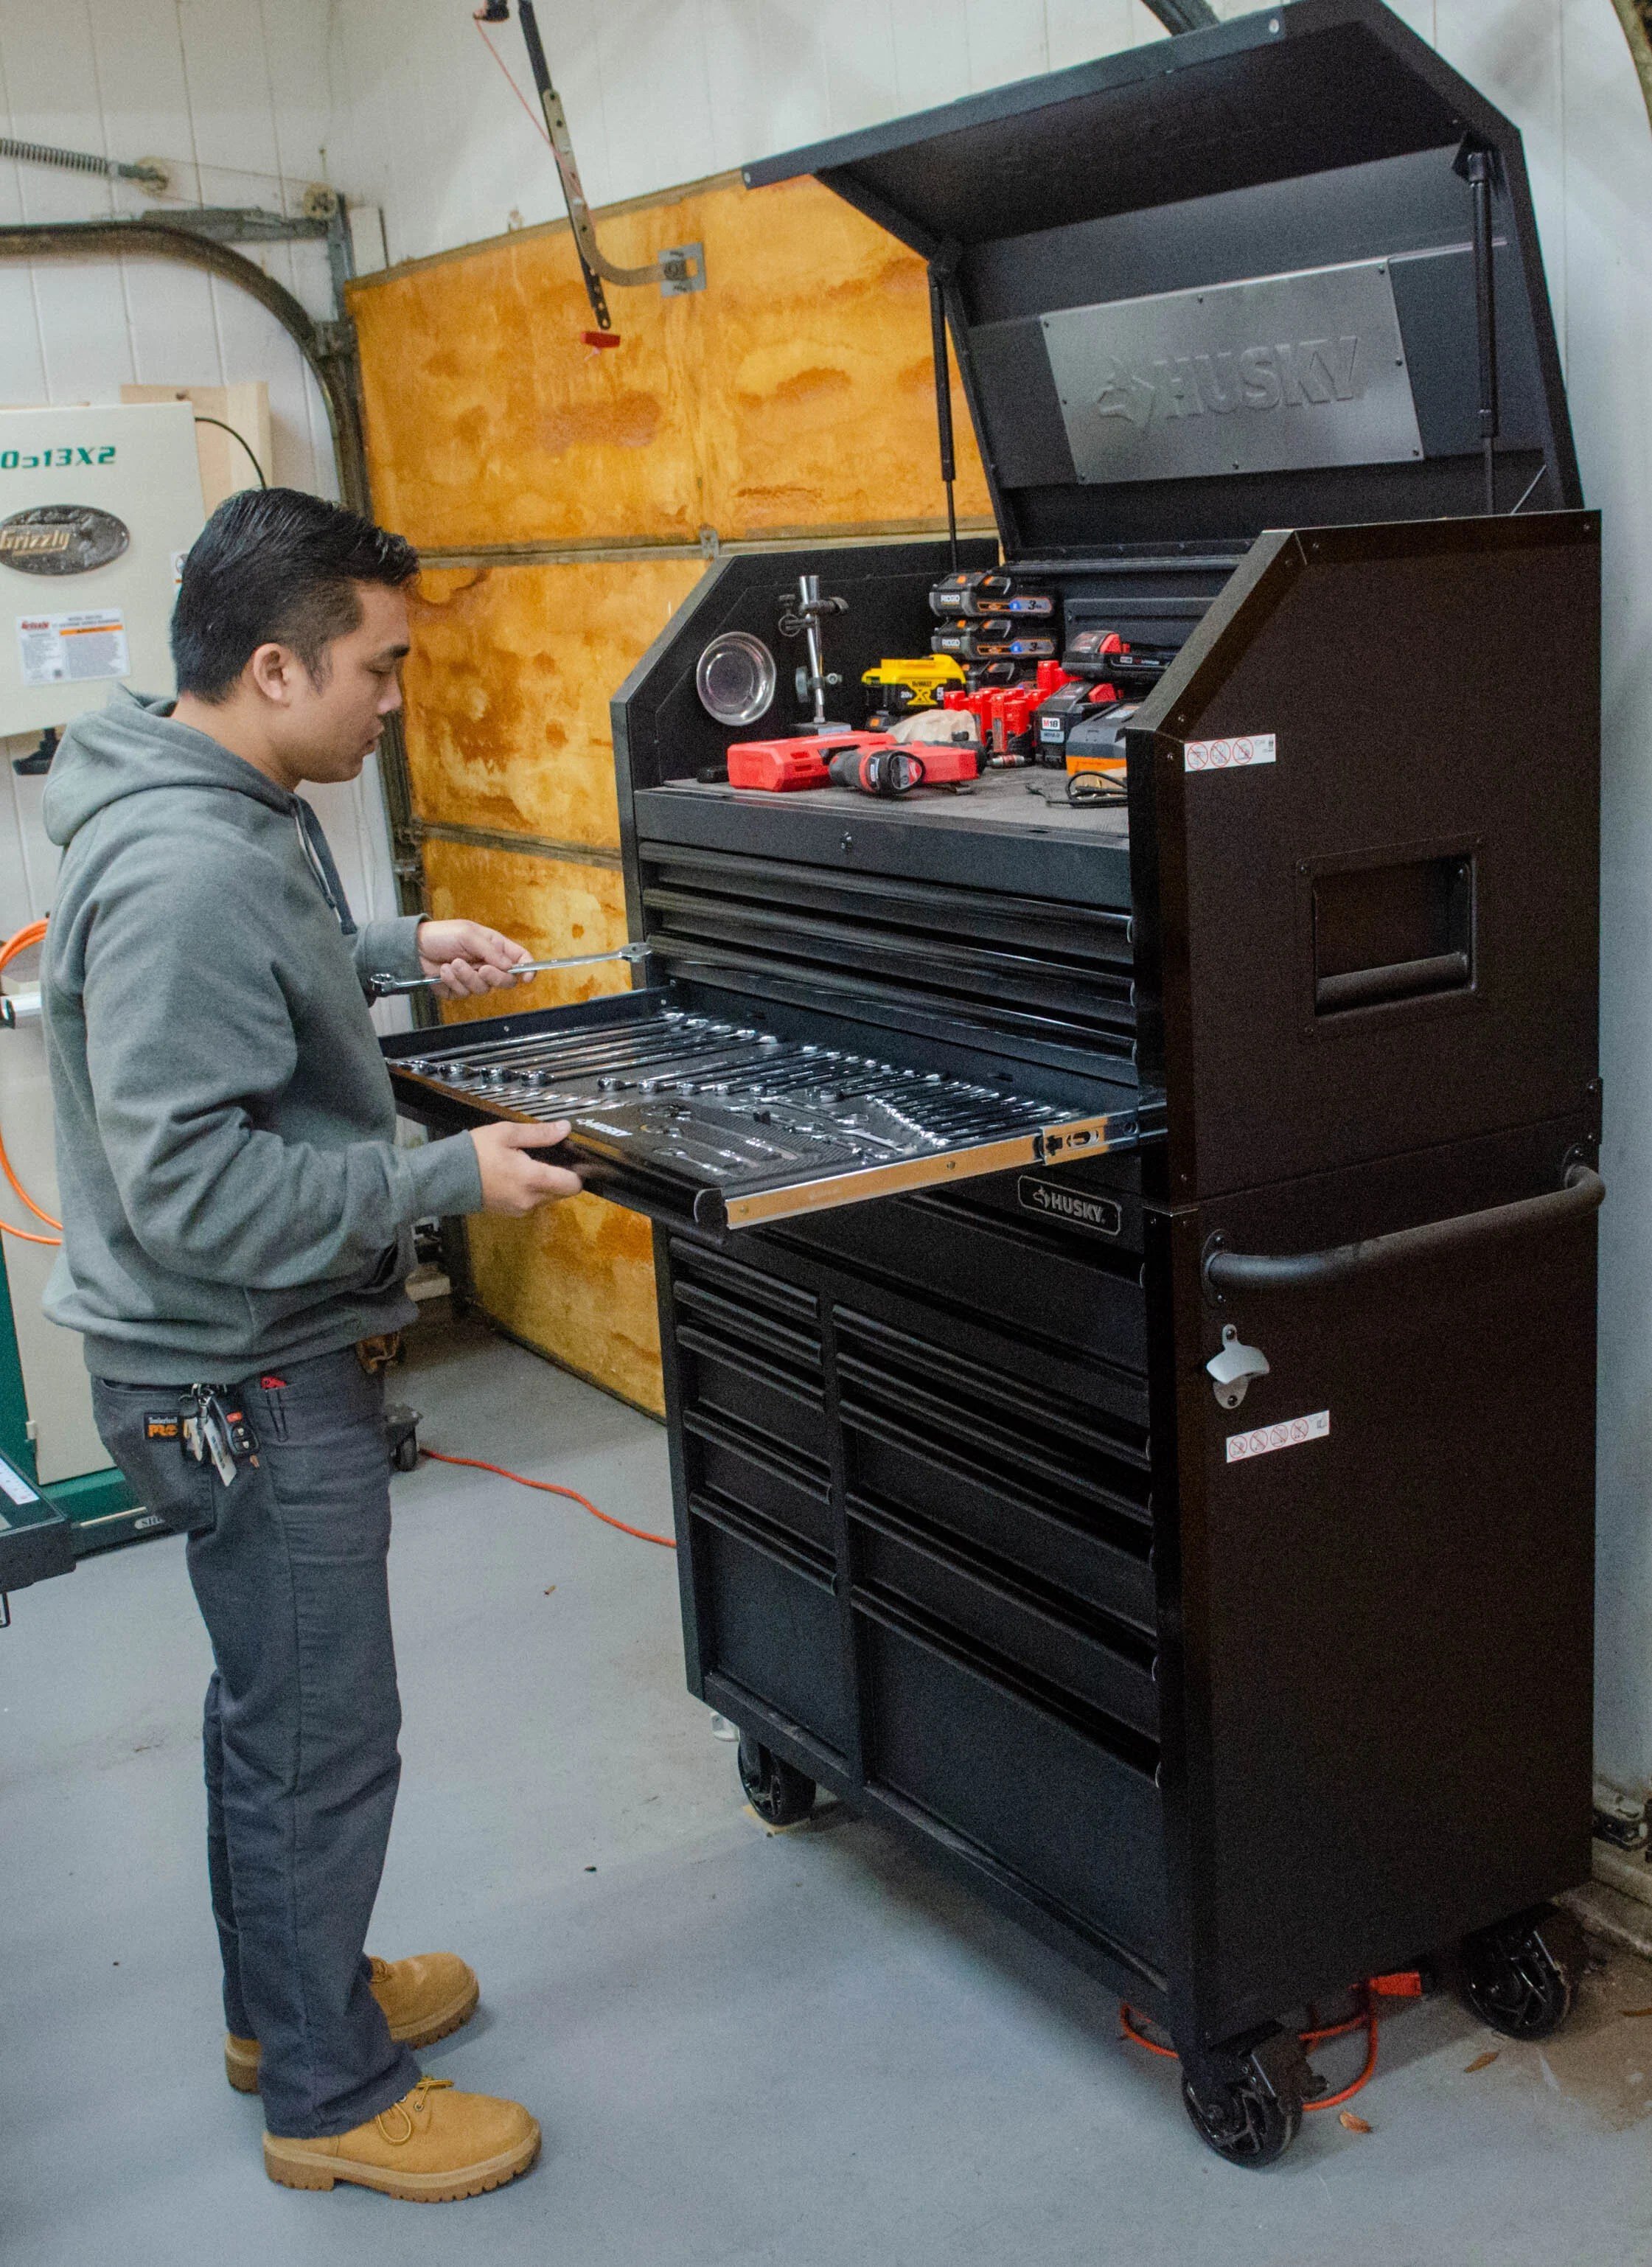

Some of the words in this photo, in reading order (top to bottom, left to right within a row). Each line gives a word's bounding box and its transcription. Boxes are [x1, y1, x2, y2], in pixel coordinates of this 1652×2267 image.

[1153, 335, 1358, 419] HUSKY
[1042, 720, 1059, 728] M18
[1051, 1192, 1104, 1223] HUSKY
[148, 1424, 177, 1438] PRO
